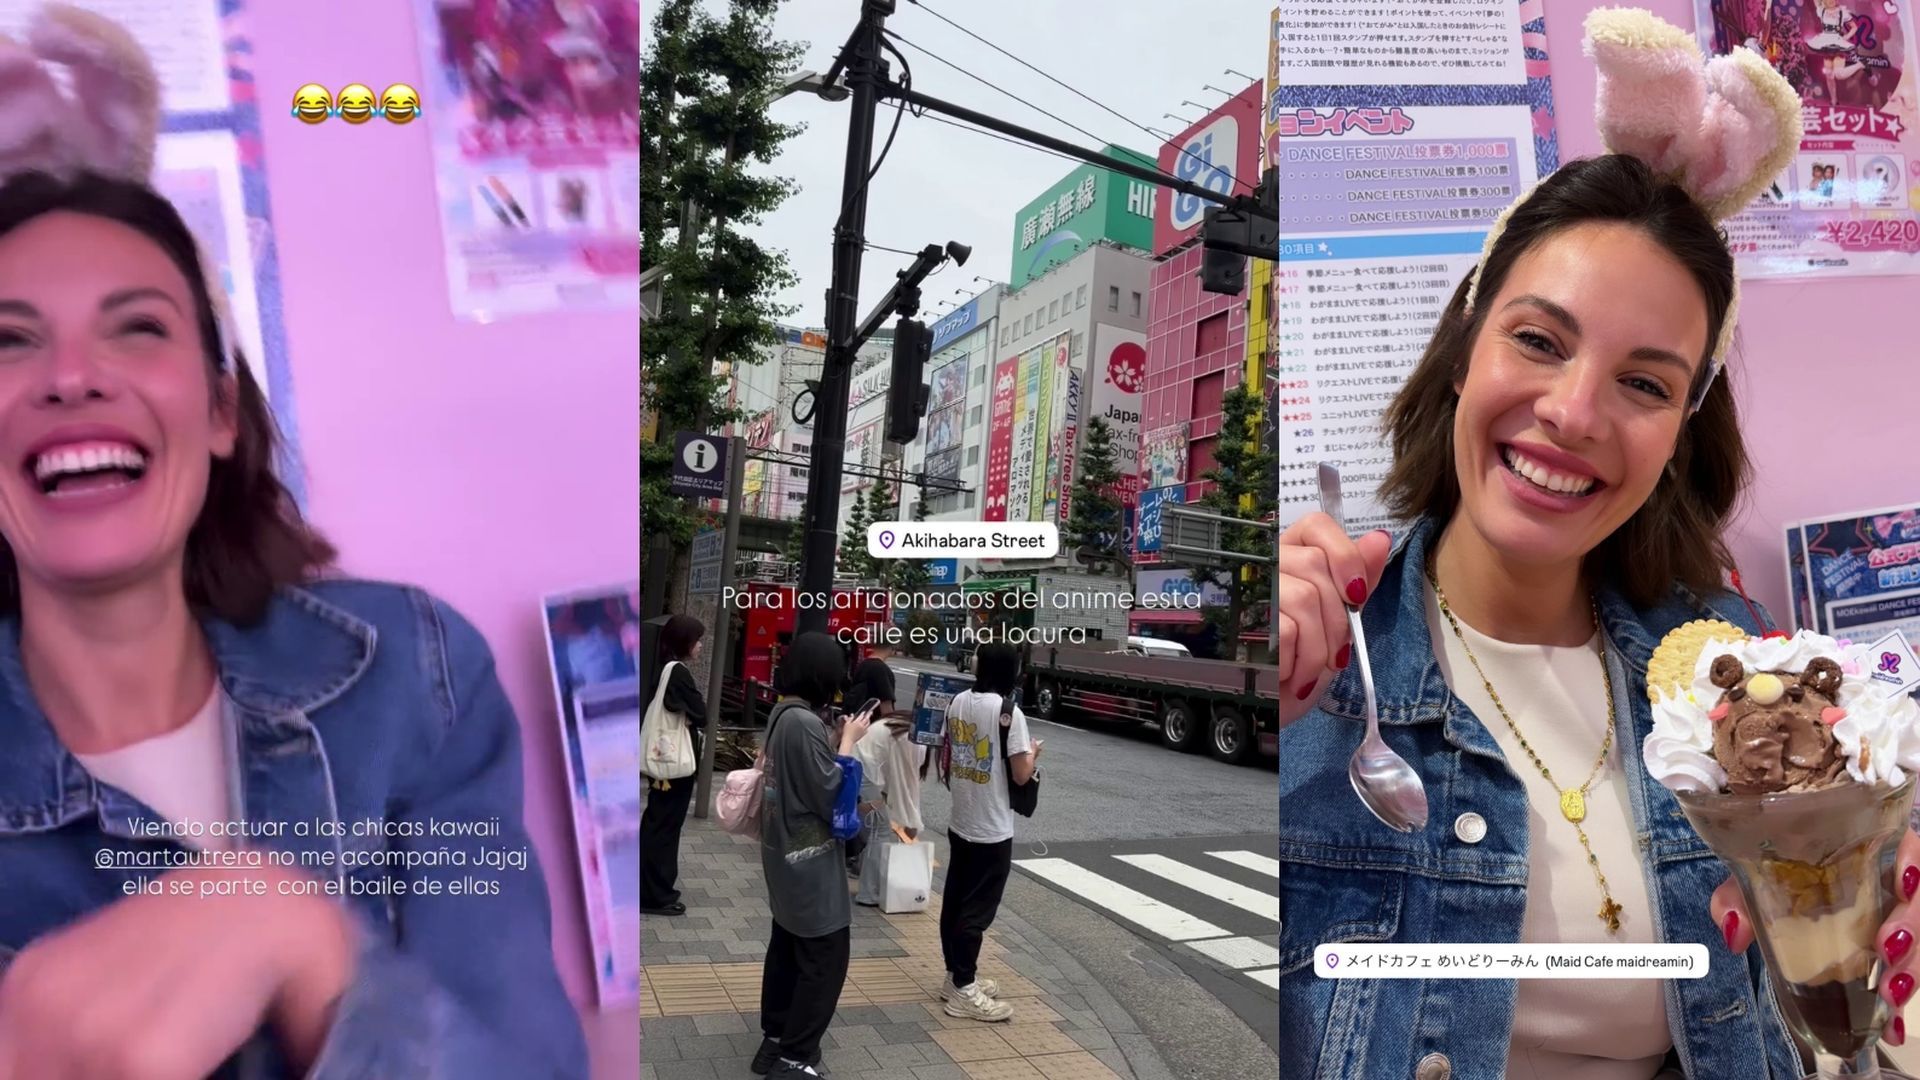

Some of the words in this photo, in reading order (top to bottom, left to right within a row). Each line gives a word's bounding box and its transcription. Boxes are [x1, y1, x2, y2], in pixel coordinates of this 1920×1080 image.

[1287, 147, 1344, 161] DANCE
[1345, 168, 1388, 180] DANCE
[1347, 189, 1390, 202] DANCE
[1349, 211, 1393, 224] DANCE
[1066, 369, 1080, 413] AKKY
[1060, 484, 1074, 519] Shop
